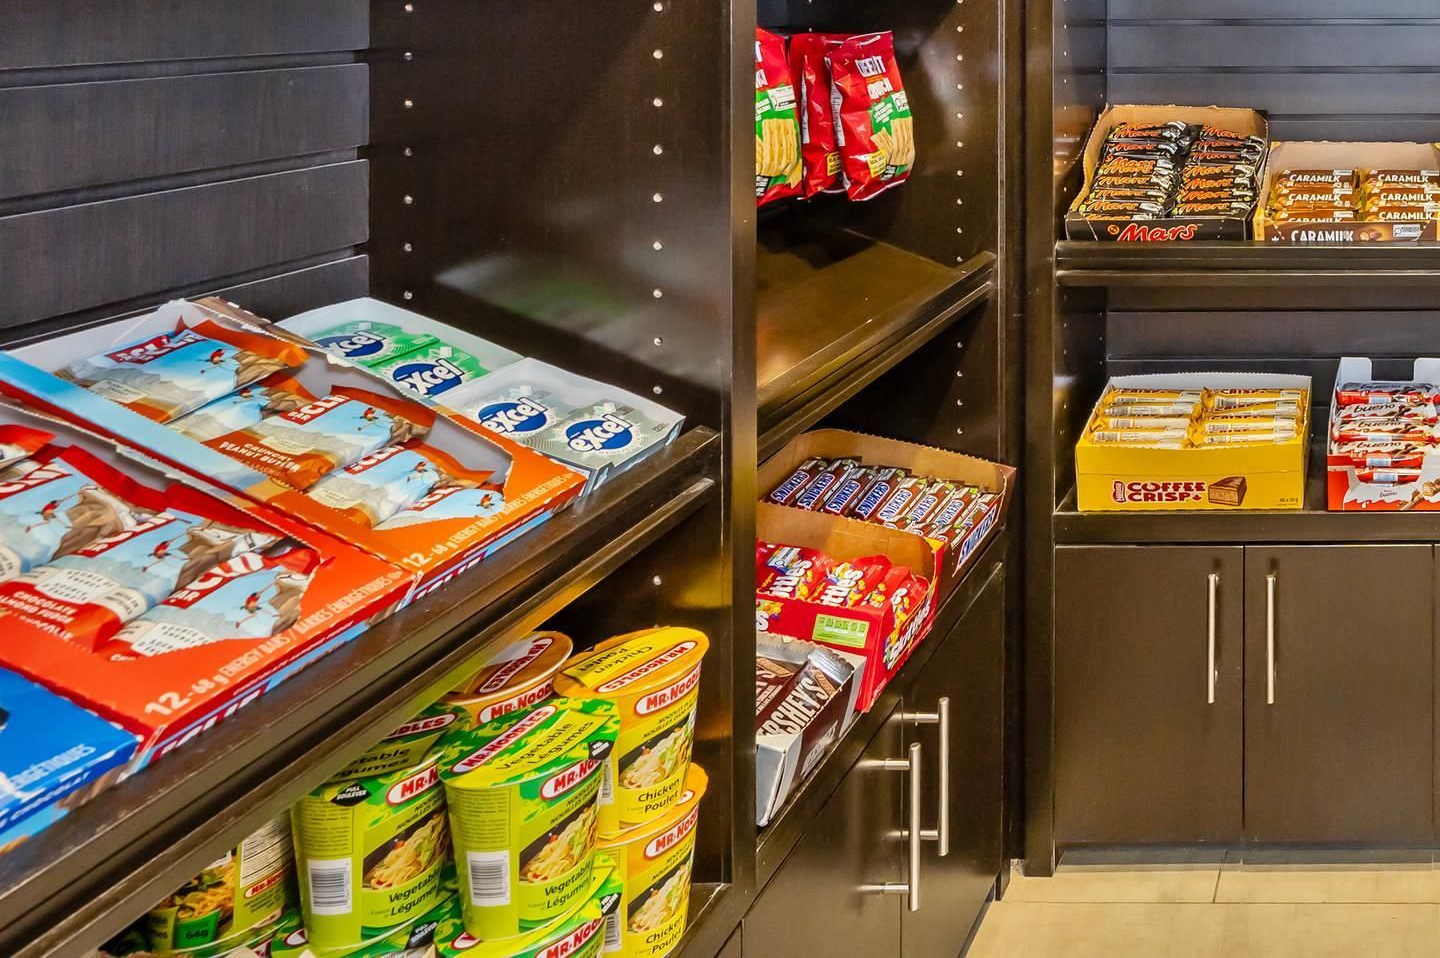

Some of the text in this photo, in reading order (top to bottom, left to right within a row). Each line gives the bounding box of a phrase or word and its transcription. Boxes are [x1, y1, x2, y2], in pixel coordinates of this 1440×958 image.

[1290, 173, 1341, 183] CARAMILK
[1378, 173, 1430, 183] CARAMILK
[1288, 193, 1342, 202] CARAMILK
[1380, 192, 1433, 202] CARAMILK
[1379, 211, 1434, 220] CARAMILK
[1118, 223, 1199, 242] Mars
[329, 331, 382, 357] xcel
[219, 441, 259, 460] PEANUT
[773, 471, 807, 502] SNICKERS
[799, 473, 835, 507] SNICKERS
[827, 482, 859, 512] SNICKERS
[857, 482, 889, 516] SNICKERS
[1127, 482, 1205, 492] COFFEE
[1127, 492, 1190, 502] CRISP
[879, 489, 912, 520] SNICKERS
[12, 591, 78, 617] CHOCOLATE
[37, 609, 75, 626] FUDGE
[220, 644, 266, 677] ENERGY
[260, 630, 292, 655] BARS
[298, 609, 333, 636] BARRES
[576, 648, 629, 674] Poulet
[594, 644, 654, 675] Chicken
[496, 723, 574, 771] Vegetable
[528, 721, 594, 766] Légumes
[637, 778, 680, 803] Chicken
[645, 788, 681, 814] Poulet
[646, 914, 684, 945] Chicken
[652, 925, 683, 955] Poulet
